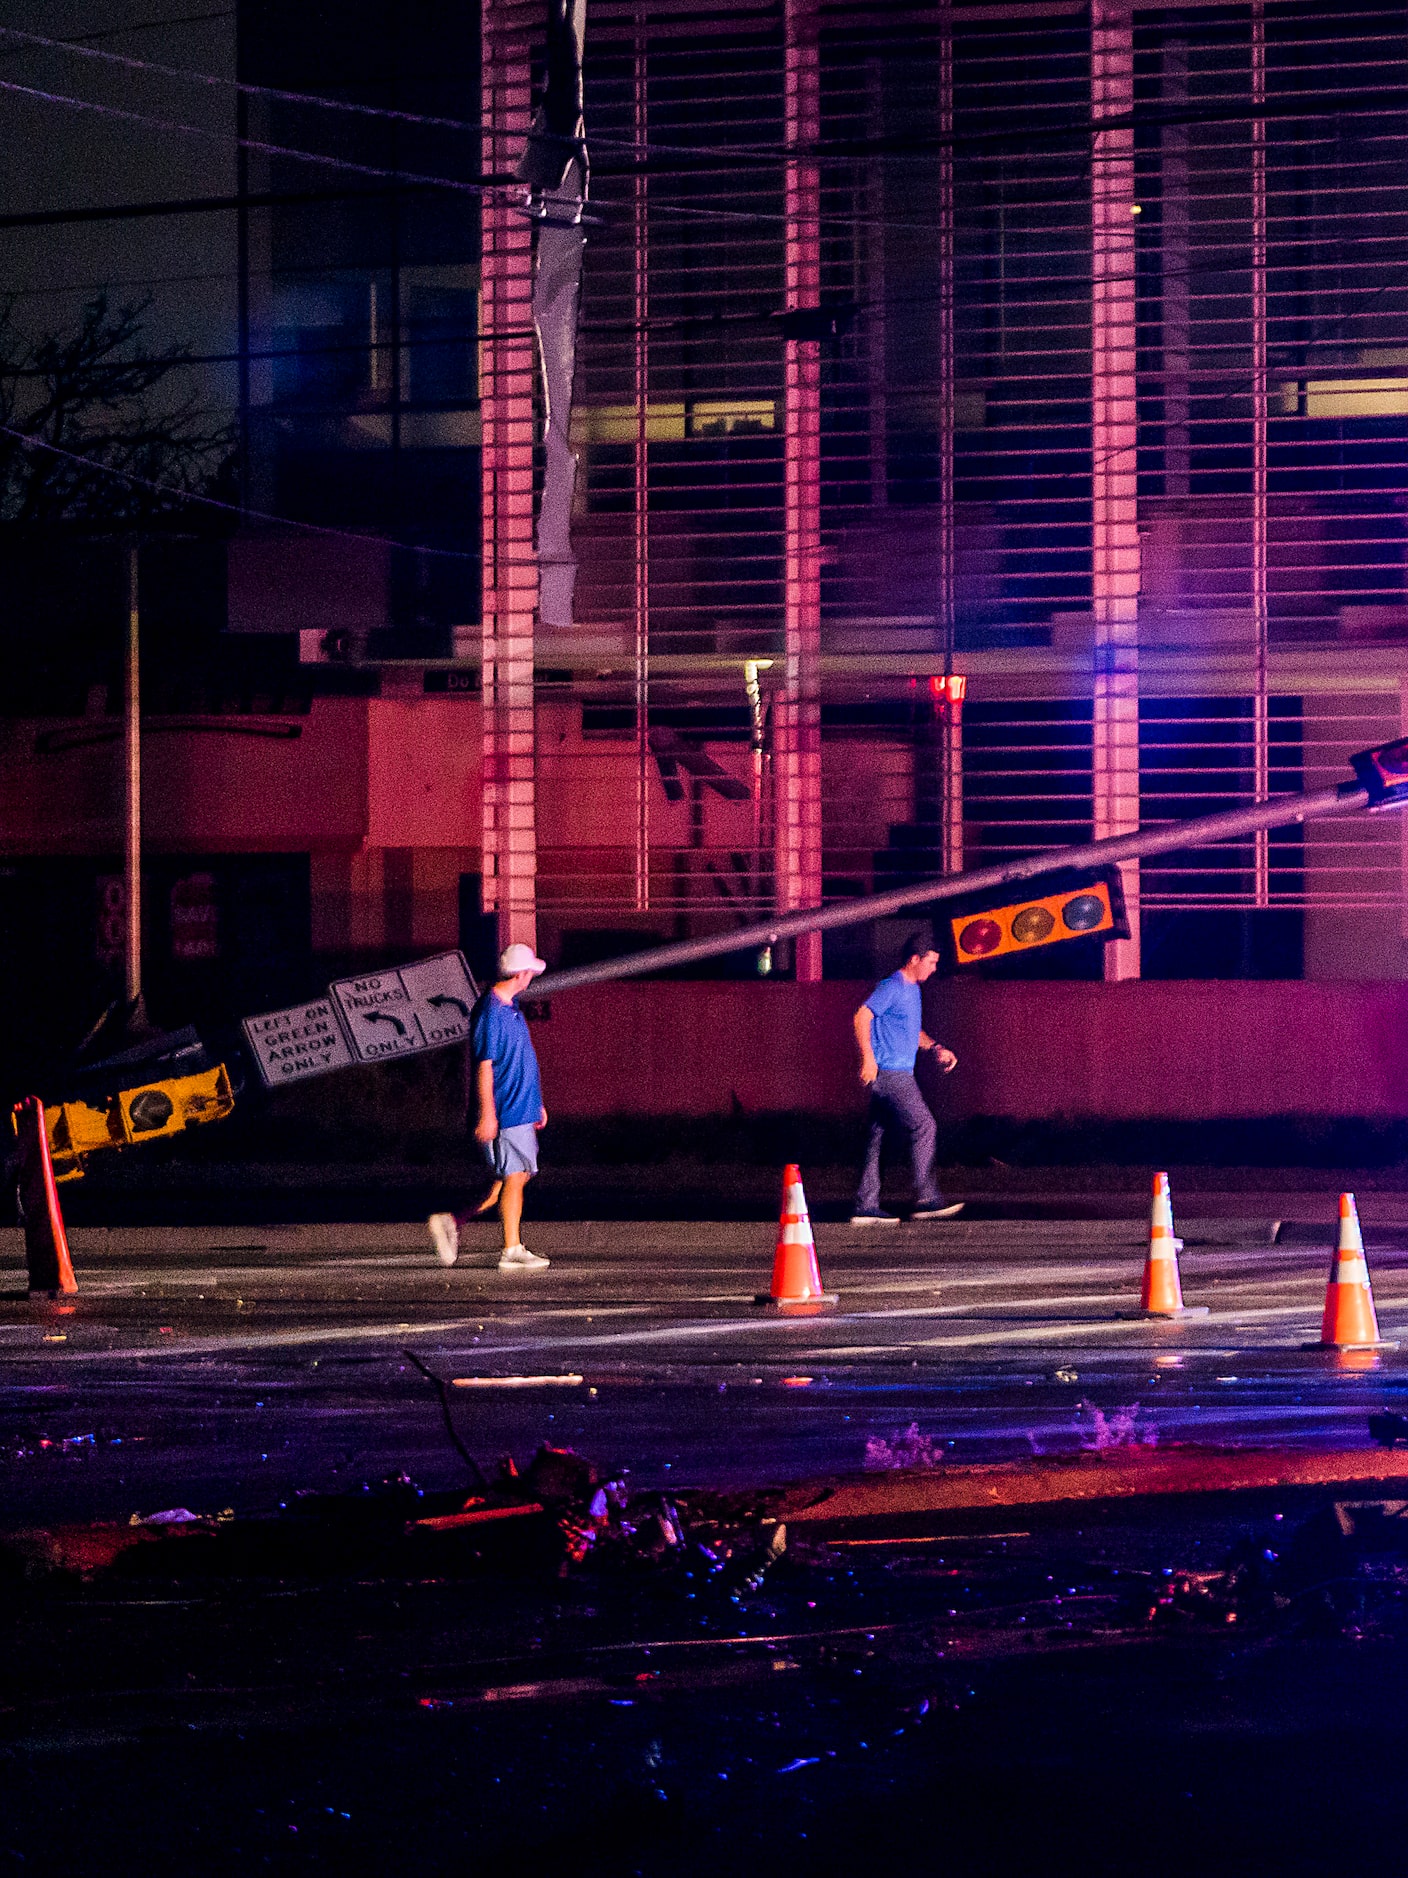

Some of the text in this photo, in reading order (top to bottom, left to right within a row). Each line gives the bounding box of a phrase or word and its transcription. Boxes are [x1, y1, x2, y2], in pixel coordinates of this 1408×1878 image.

[354, 978, 382, 992] NO
[344, 988, 404, 1012] TRUCKS
[253, 1005, 330, 1034] LEFT ON
[265, 1021, 329, 1047] GREEN
[430, 1024, 464, 1041] ONL
[268, 1035, 337, 1063] ARROW
[365, 1035, 416, 1057] ONLY
[281, 1052, 332, 1075] ONLY
